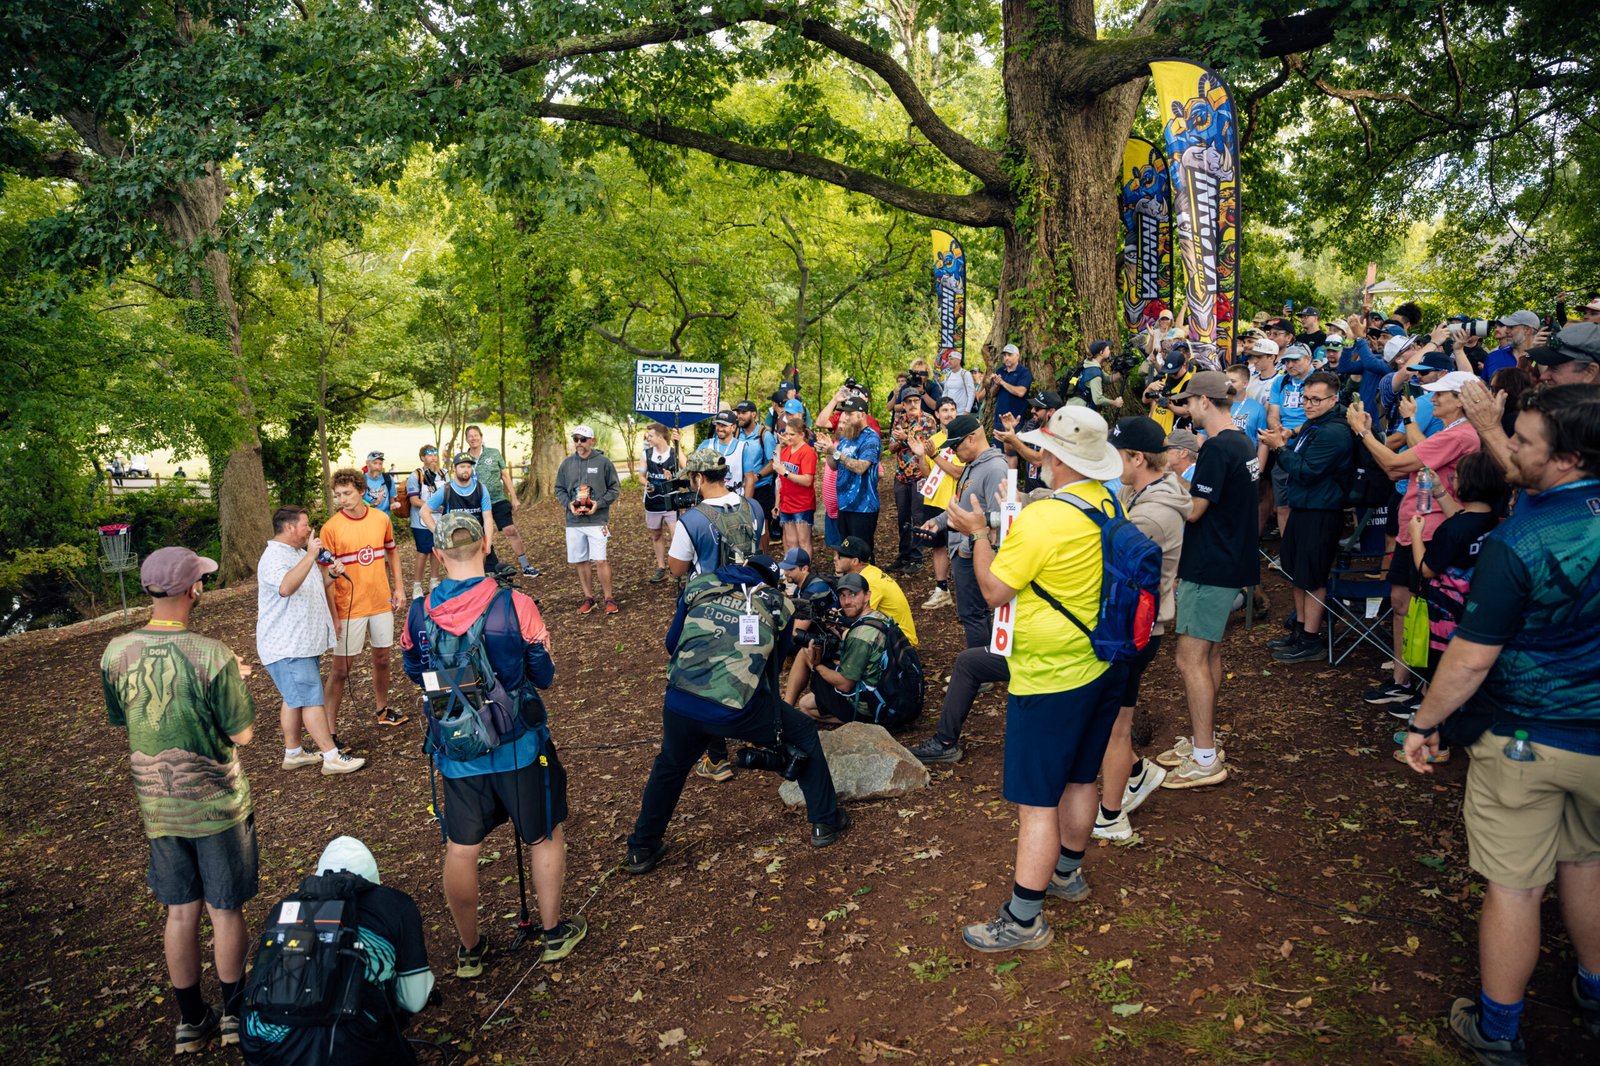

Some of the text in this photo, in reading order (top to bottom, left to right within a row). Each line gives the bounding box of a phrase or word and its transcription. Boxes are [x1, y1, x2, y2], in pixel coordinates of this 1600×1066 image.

[1195, 171, 1217, 292] INNOVA
[1142, 215, 1158, 298] INNOVA
[1193, 234, 1206, 292] DISC GOLF
[942, 287, 954, 348] INNOVA
[642, 363, 716, 374] PDGA MAJOR
[637, 376, 665, 385] BUHR
[637, 385, 718, 397] HEIMBURG -23
[637, 394, 685, 404] WYSOCKI
[636, 403, 717, 414] ANTTILA -15
[714, 629, 723, 639] 2
